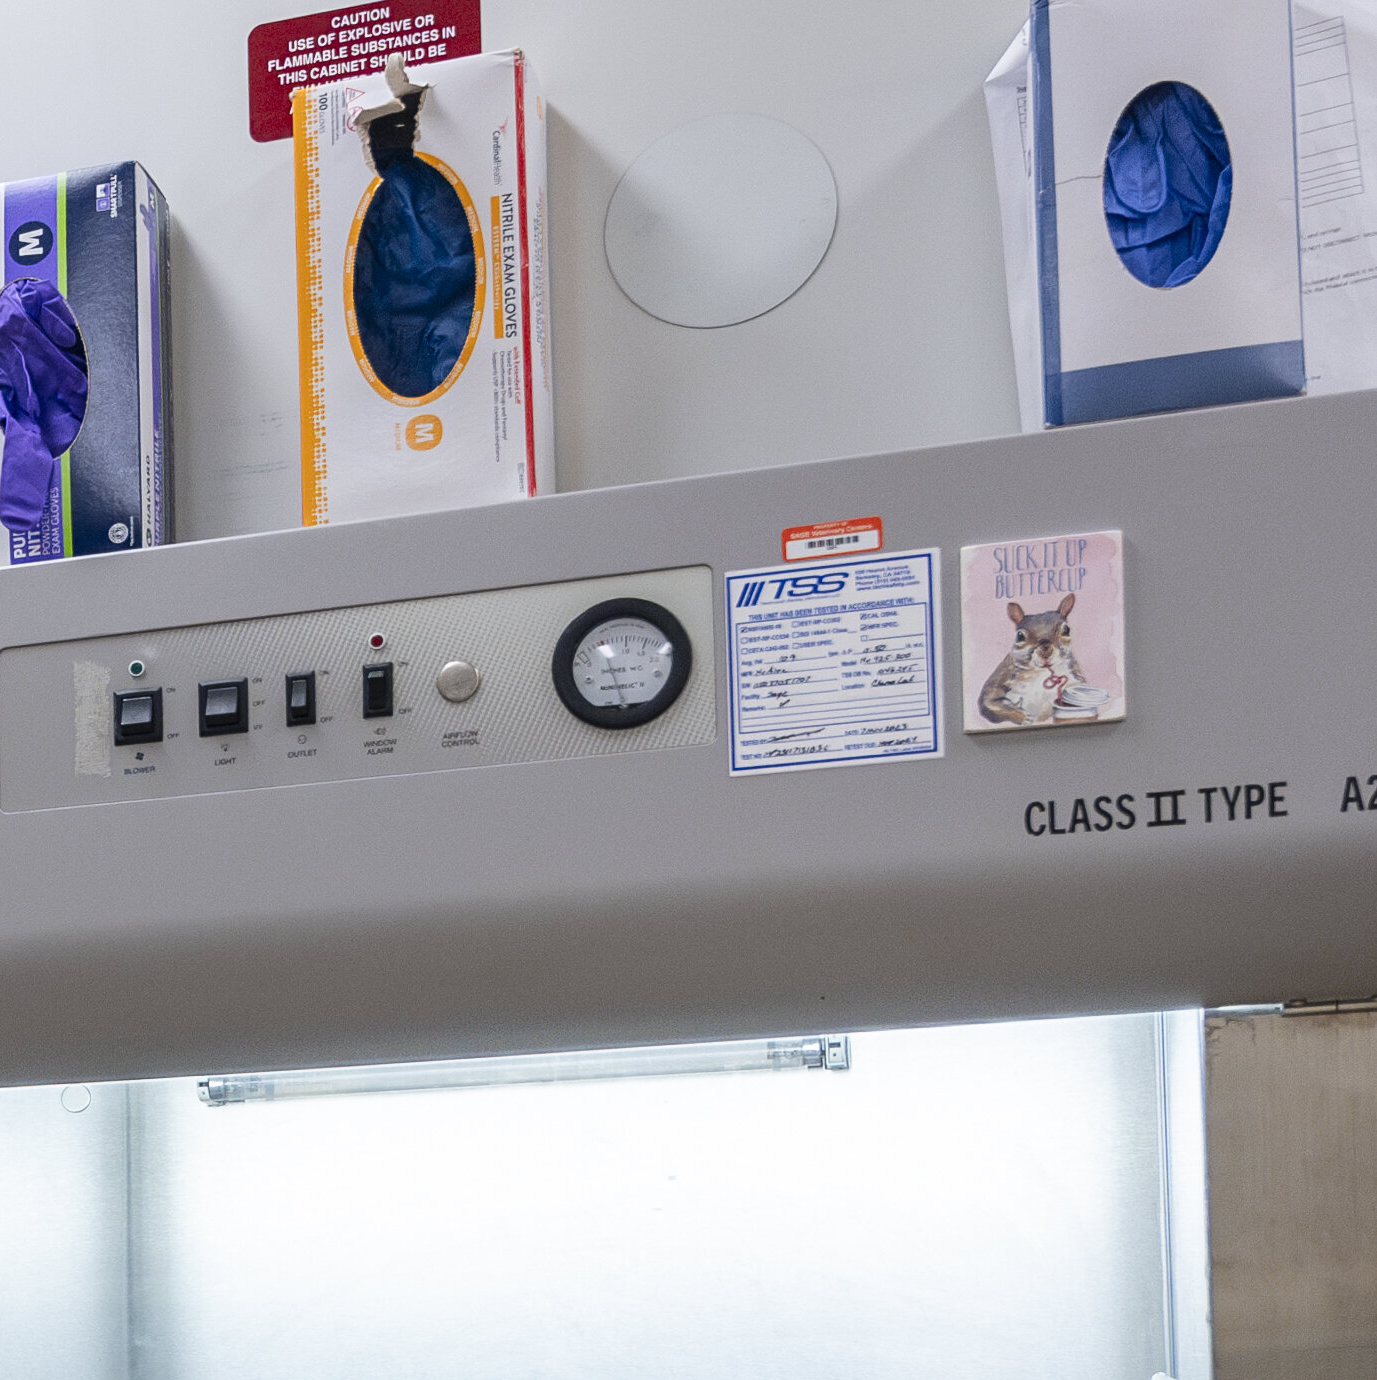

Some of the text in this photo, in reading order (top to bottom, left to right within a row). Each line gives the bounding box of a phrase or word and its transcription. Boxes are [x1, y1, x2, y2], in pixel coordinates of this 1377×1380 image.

[331, 7, 390, 28] CAUTION
[288, 14, 434, 52] USE OF EXPLOSIVE OR
[267, 26, 456, 72] FLAMMABLE SUBSTANCES IN
[278, 70, 307, 85] THIS
[310, 58, 368, 81] CABINET
[428, 44, 446, 56] BE
[319, 93, 328, 111] 100
[19, 228, 43, 256] M
[501, 193, 518, 338] NITRILE EXAM GLOVES
[415, 423, 434, 442] M
[50, 487, 60, 555] EXAM GLOVES
[993, 539, 1087, 574] SUCK IT UP
[768, 572, 849, 600] TSS
[995, 567, 1087, 599] BUTTERCUP
[363, 738, 398, 748] WINDOW
[441, 738, 481, 748] CONTROL
[443, 730, 480, 739] AIRFLOW
[214, 757, 237, 766] LIGHT
[287, 749, 318, 759] OUTLET
[366, 747, 395, 756] ALARM
[123, 765, 156, 775] BLOWER
[1024, 793, 1136, 837] CLASS
[1146, 789, 1187, 827] II
[1197, 781, 1288, 823] TYPE
